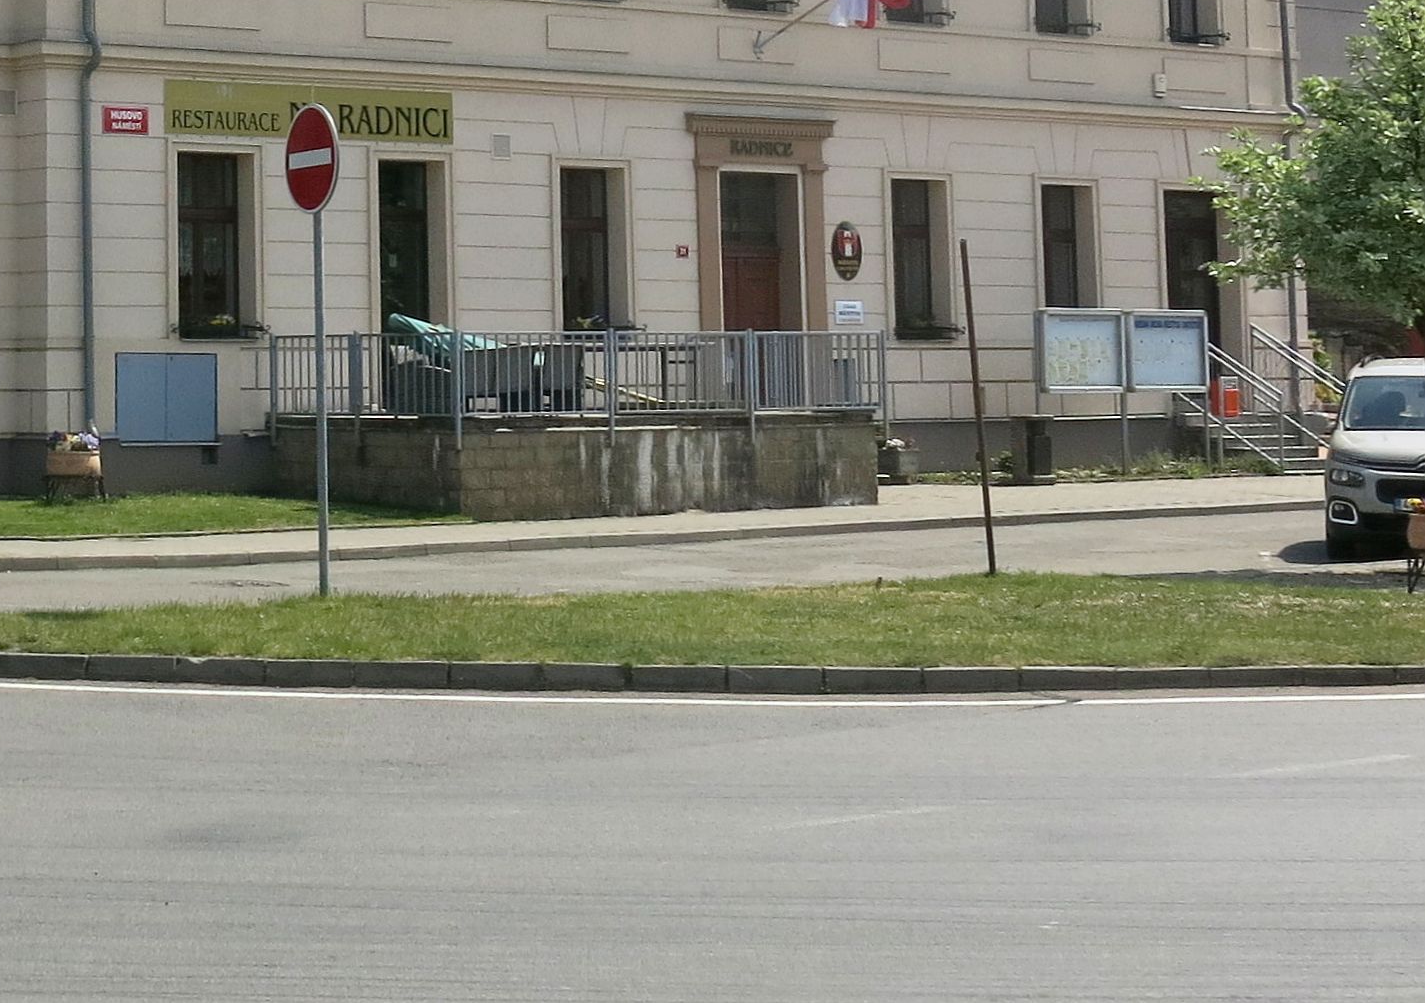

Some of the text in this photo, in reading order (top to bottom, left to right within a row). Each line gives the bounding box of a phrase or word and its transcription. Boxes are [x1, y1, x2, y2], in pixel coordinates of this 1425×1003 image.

[110, 110, 143, 120] HUSOVO
[171, 109, 281, 133] RESTAURACE
[338, 104, 449, 139] RADNICI
[730, 139, 793, 156] RADNICE
